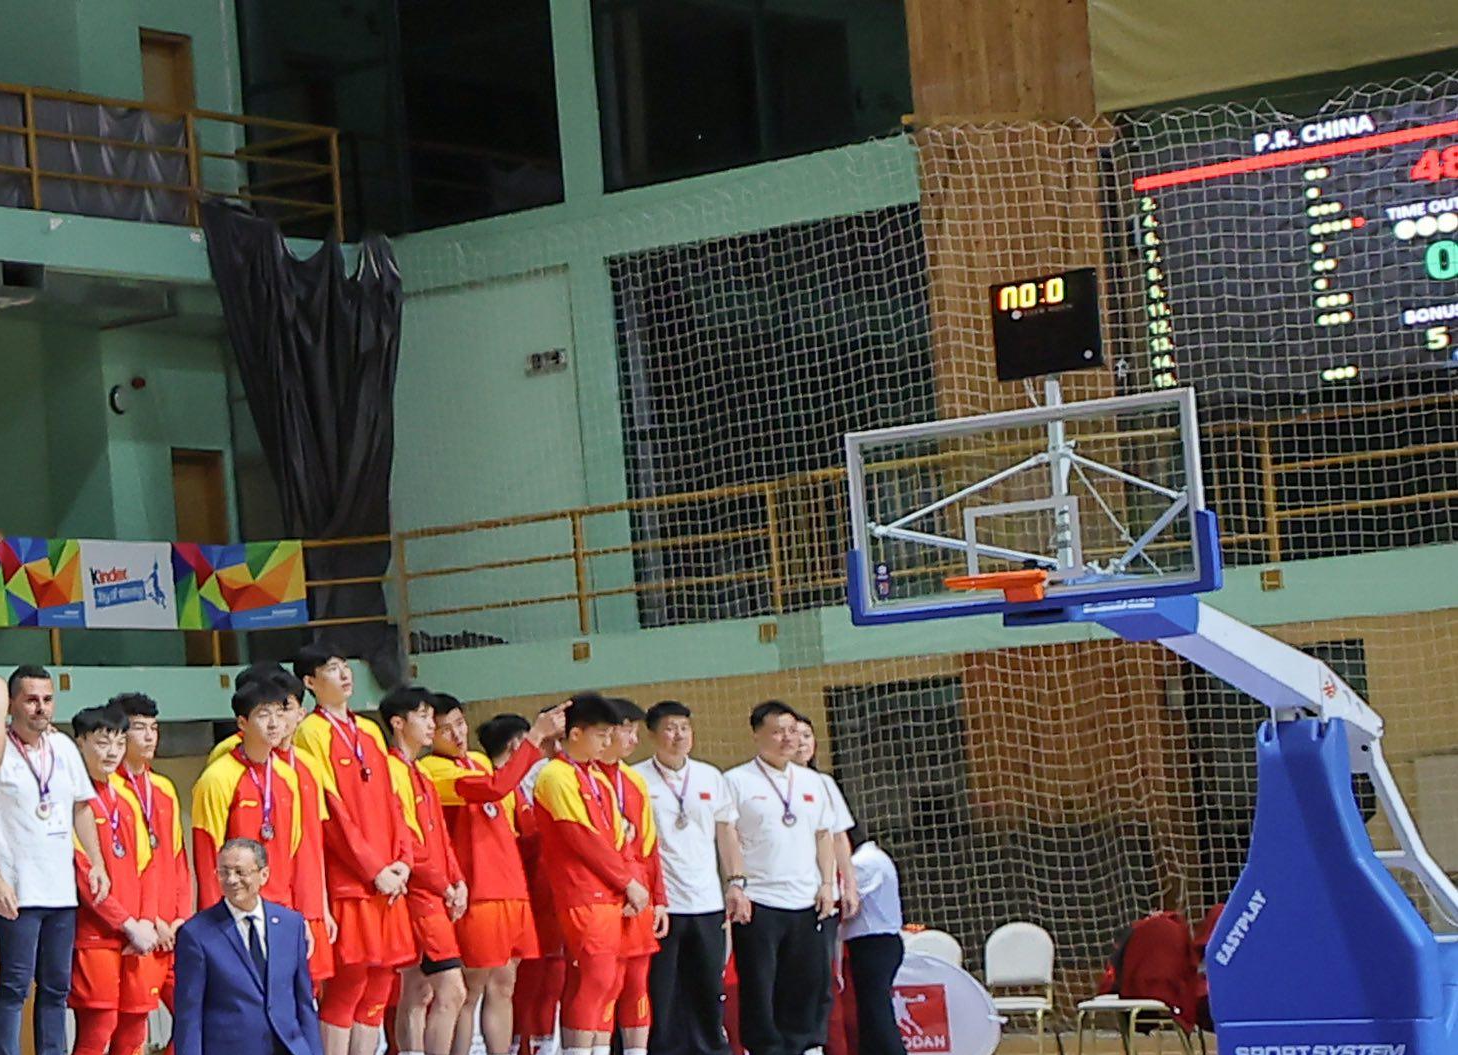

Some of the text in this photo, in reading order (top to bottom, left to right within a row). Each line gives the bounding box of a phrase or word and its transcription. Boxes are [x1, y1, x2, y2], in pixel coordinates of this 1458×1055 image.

[1254, 114, 1375, 152] P.R. CHINA
[1386, 201, 1426, 220] TIME
[1426, 326, 1452, 349] 5
[1216, 889, 1267, 966] EASYPLAY
